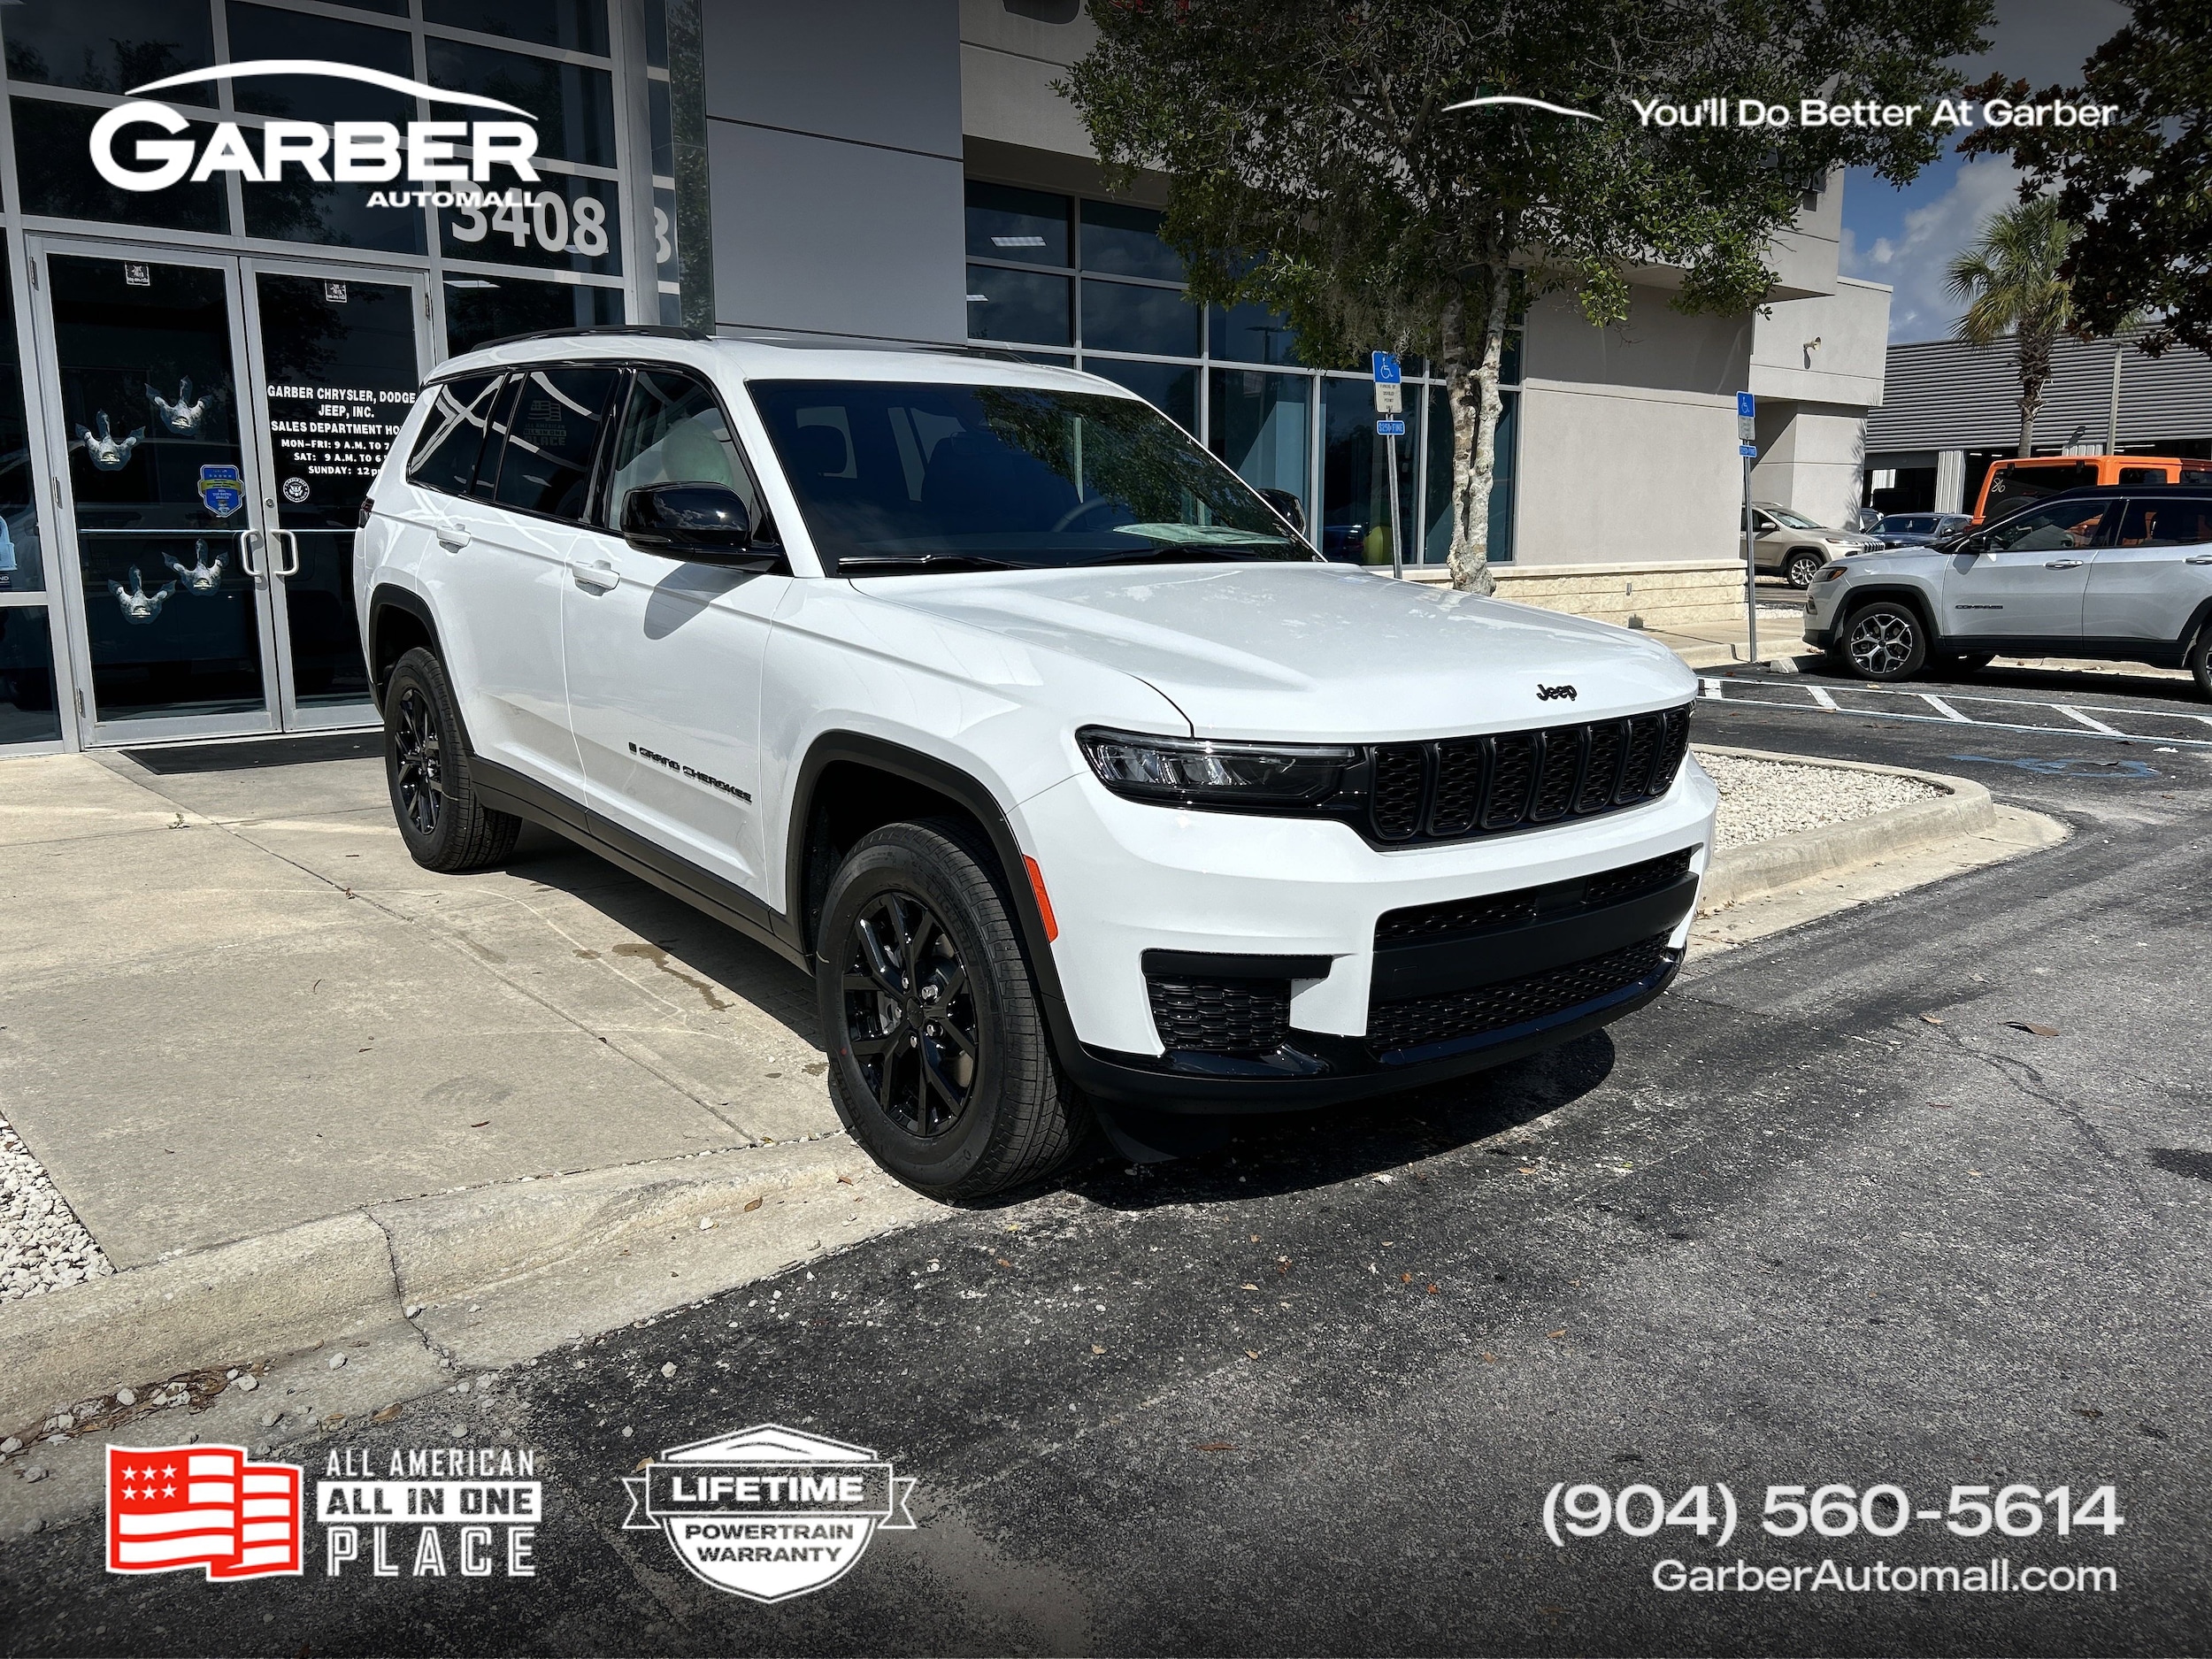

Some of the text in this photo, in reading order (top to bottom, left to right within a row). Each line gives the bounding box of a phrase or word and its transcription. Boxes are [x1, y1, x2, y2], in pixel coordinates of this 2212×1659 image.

[450, 180, 609, 257] 3408
[267, 385, 416, 404] GARBER CHRYSLER, DODGE
[319, 404, 375, 419] JEEP, INC.
[271, 420, 307, 432] SALES
[310, 422, 382, 434] DEPARTMENT
[294, 452, 317, 461] SAT:
[334, 453, 357, 462] A.M.
[309, 466, 352, 475] SUNDAY:
[1536, 684, 1578, 702] Jeep
[639, 747, 752, 805] GRAND CHEROKEE
